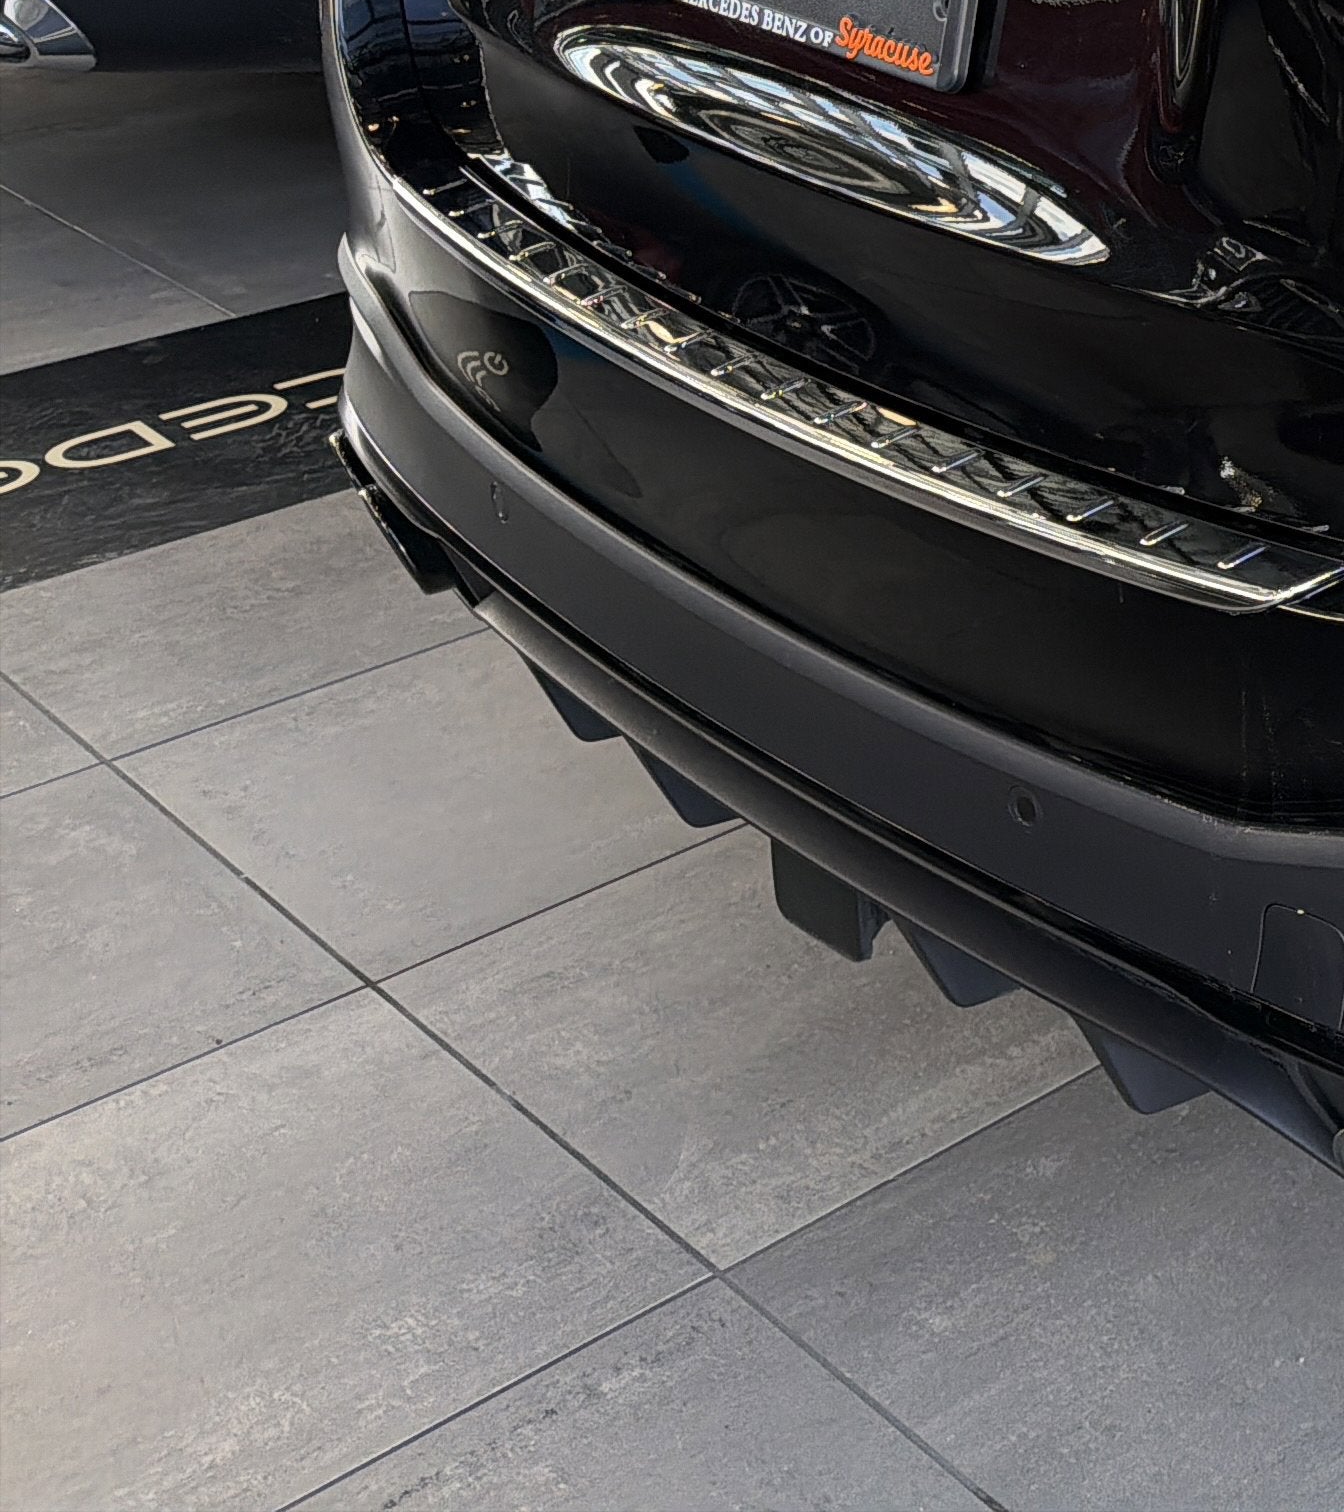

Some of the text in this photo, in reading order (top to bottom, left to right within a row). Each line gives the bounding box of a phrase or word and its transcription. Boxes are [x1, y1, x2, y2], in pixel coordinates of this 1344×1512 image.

[761, 12, 808, 44] BENZ
[810, 26, 834, 49] OF
[834, 15, 935, 77] Syracuse
